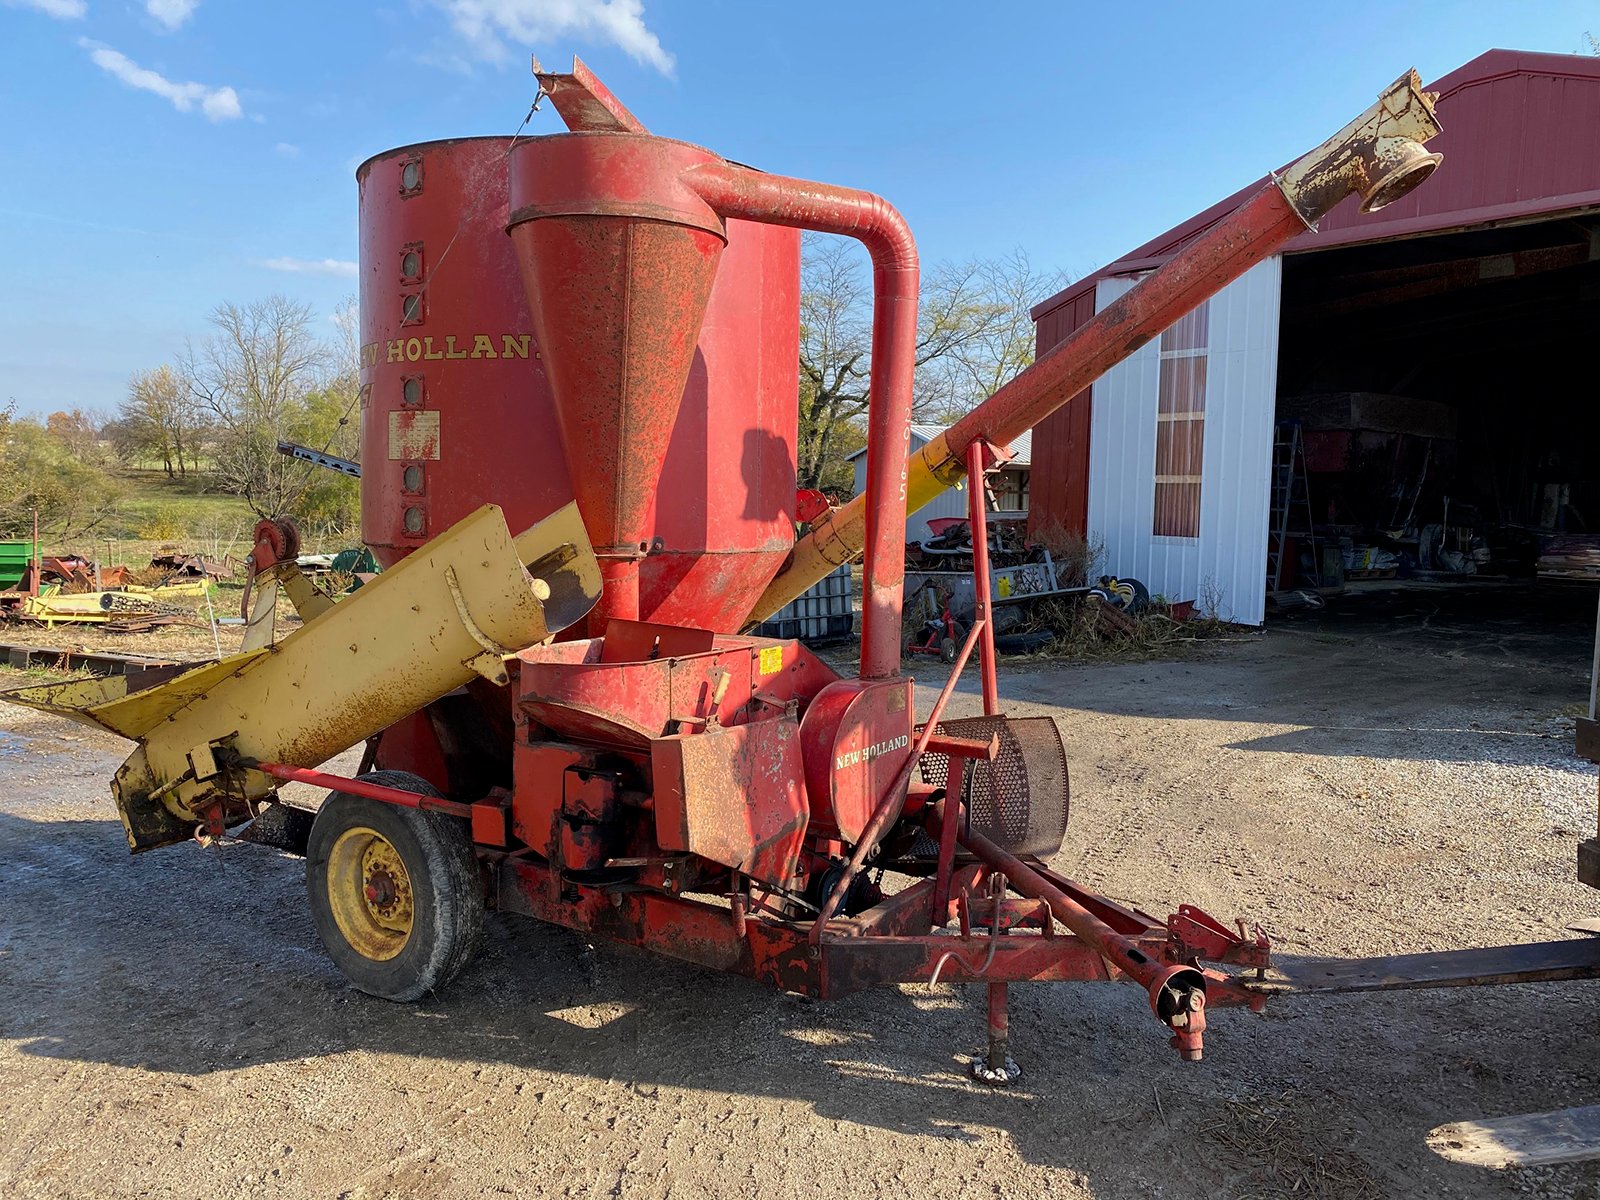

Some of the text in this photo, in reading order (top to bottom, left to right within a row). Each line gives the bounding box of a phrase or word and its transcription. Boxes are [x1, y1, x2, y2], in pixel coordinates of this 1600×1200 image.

[386, 334, 541, 364] HOLLAN
[836, 735, 908, 770] NEW HOLLAND
